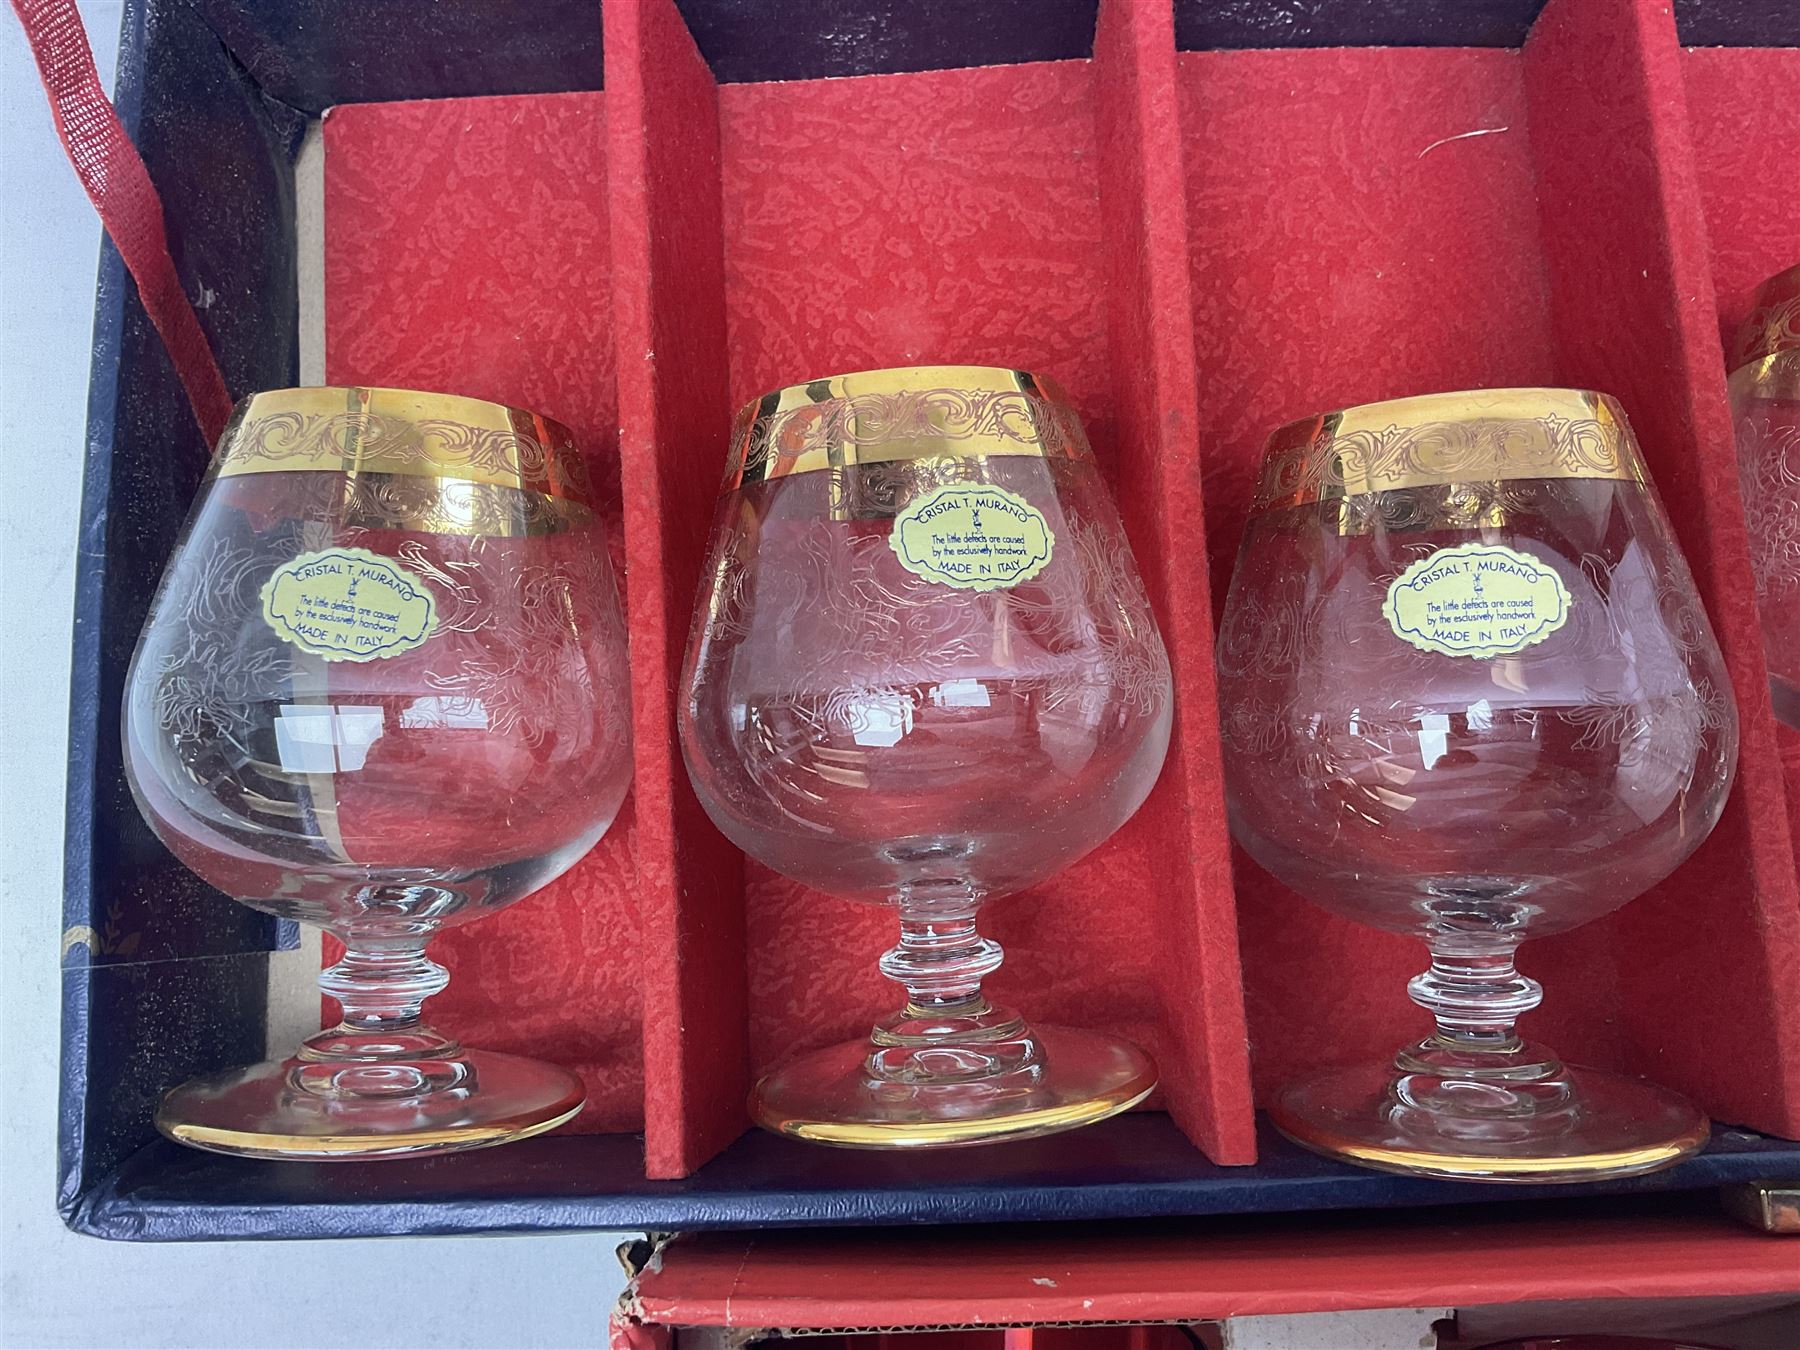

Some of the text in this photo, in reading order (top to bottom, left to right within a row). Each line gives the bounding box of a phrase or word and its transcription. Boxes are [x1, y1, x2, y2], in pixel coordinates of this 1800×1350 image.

[919, 498, 1027, 524] CRISTAL T. MURANO
[932, 535, 944, 544] The
[947, 533, 960, 543] little
[964, 532, 987, 543] defects
[1002, 534, 1024, 543] caused
[932, 547, 941, 558] by
[944, 546, 954, 555] the
[994, 544, 1027, 555] handwork
[938, 560, 1020, 574] MADE IN ITALY
[1413, 562, 1538, 592] CRISTAL T. MURANO
[295, 565, 413, 601] CRISTAL T. MURANO
[300, 595, 399, 622] The little defects are caused
[1427, 602, 1440, 612] The
[1443, 601, 1459, 610] little
[1462, 598, 1488, 609] defects
[1507, 596, 1533, 607] caused
[294, 609, 303, 618] by
[306, 610, 317, 619] the
[359, 618, 397, 634] handwork
[1427, 614, 1436, 626] by
[1440, 613, 1451, 623] the
[1497, 608, 1535, 620] handwork
[296, 624, 383, 646] MADE IN ITALY
[1433, 624, 1528, 641] MADE IN ITALY
